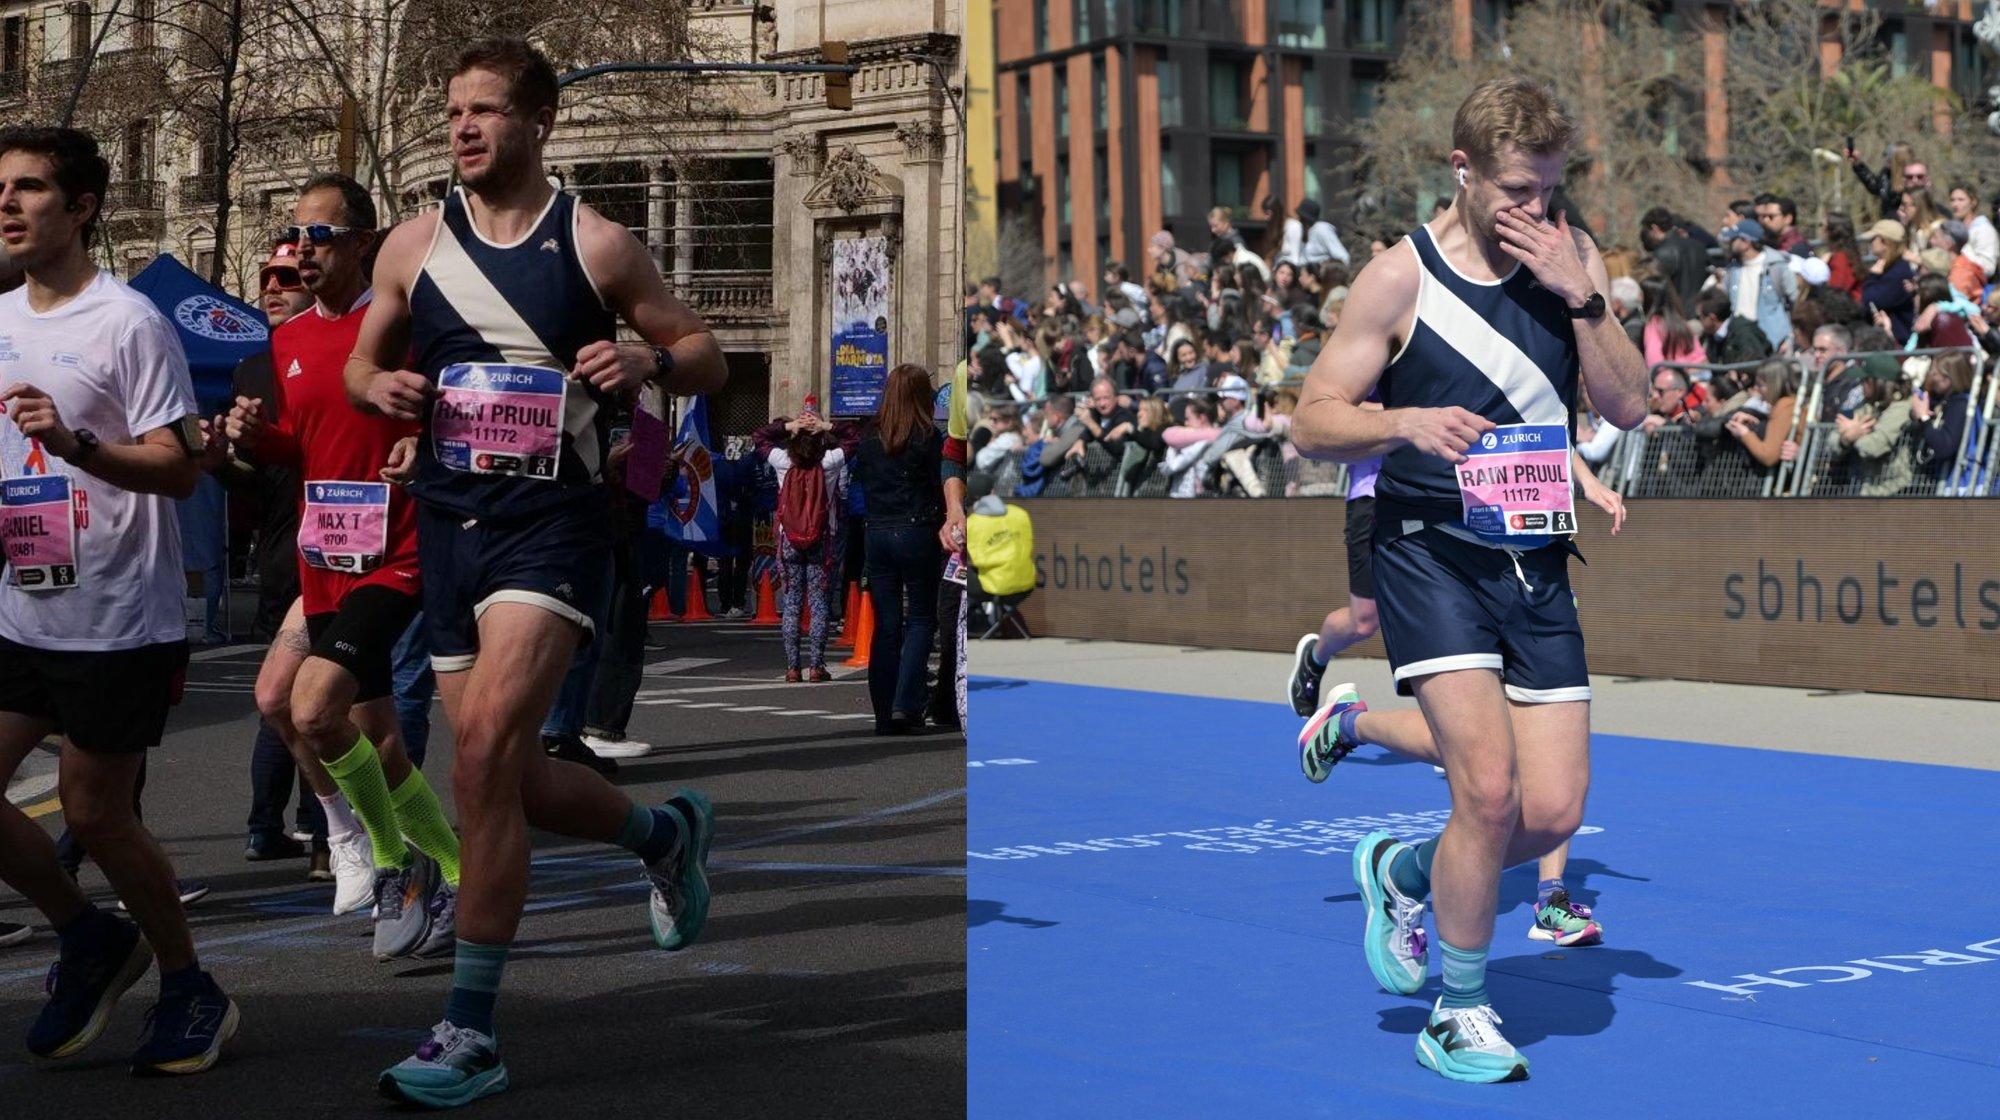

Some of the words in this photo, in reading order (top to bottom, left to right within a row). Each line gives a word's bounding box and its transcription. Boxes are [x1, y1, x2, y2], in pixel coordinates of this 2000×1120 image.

[489, 373, 533, 384] ZURICH
[438, 401, 484, 421] RAIN
[491, 404, 557, 428] PRUUL
[474, 427, 517, 443] 11172
[1502, 433, 1541, 445] ZURICH
[1460, 466, 1508, 487] RAIN
[1514, 464, 1567, 483] PRUUL
[10, 486, 41, 497] ZURICH
[326, 488, 363, 498] ZURICH
[1502, 487, 1540, 502] 11172
[318, 512, 346, 530] MAX
[352, 513, 361, 530] T
[323, 533, 348, 546] 9700
[1035, 543, 1189, 595] sbhotels
[1724, 557, 2000, 631] sbhotels
